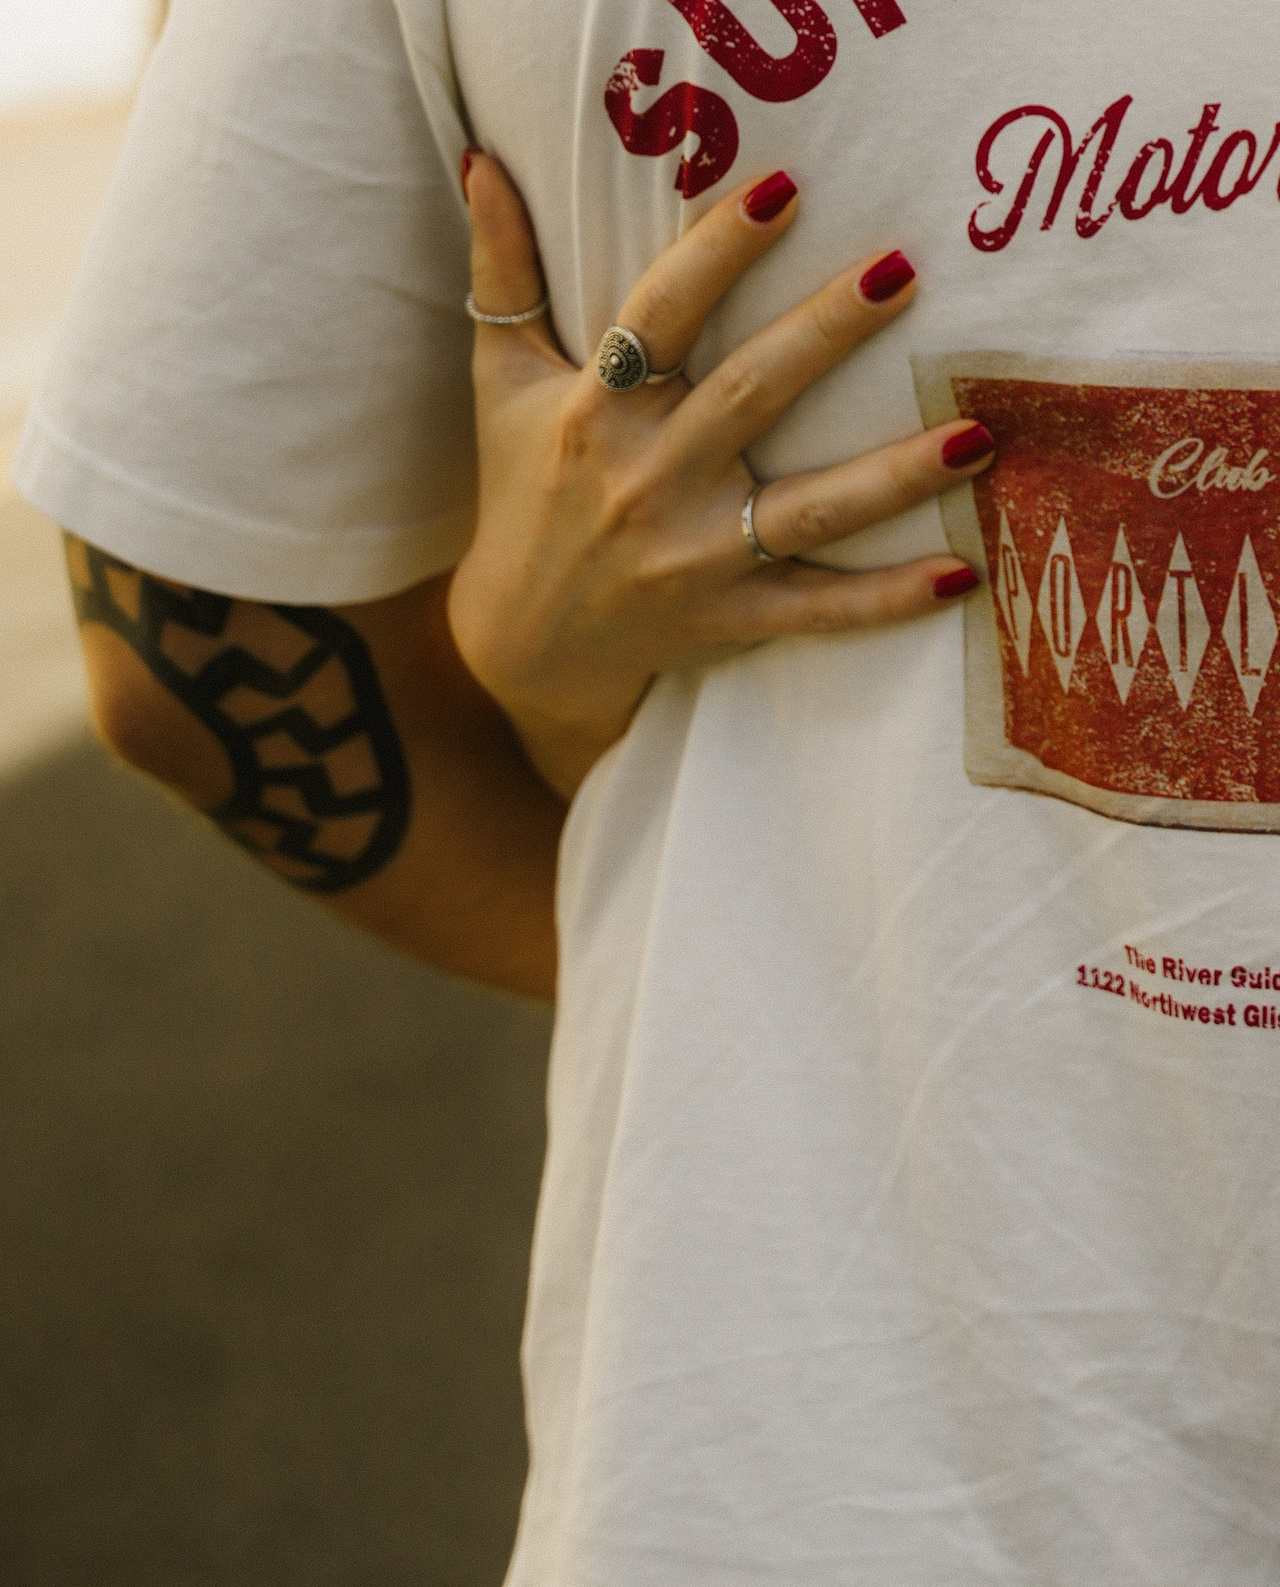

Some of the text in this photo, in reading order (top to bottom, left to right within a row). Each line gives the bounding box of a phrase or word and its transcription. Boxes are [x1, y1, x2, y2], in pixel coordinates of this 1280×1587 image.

[1148, 437, 1276, 499] Club
[1077, 964, 1126, 997] 1122
[1129, 980, 1237, 1026] Northwest
[1124, 944, 1156, 974] The
[1161, 956, 1223, 986] River
